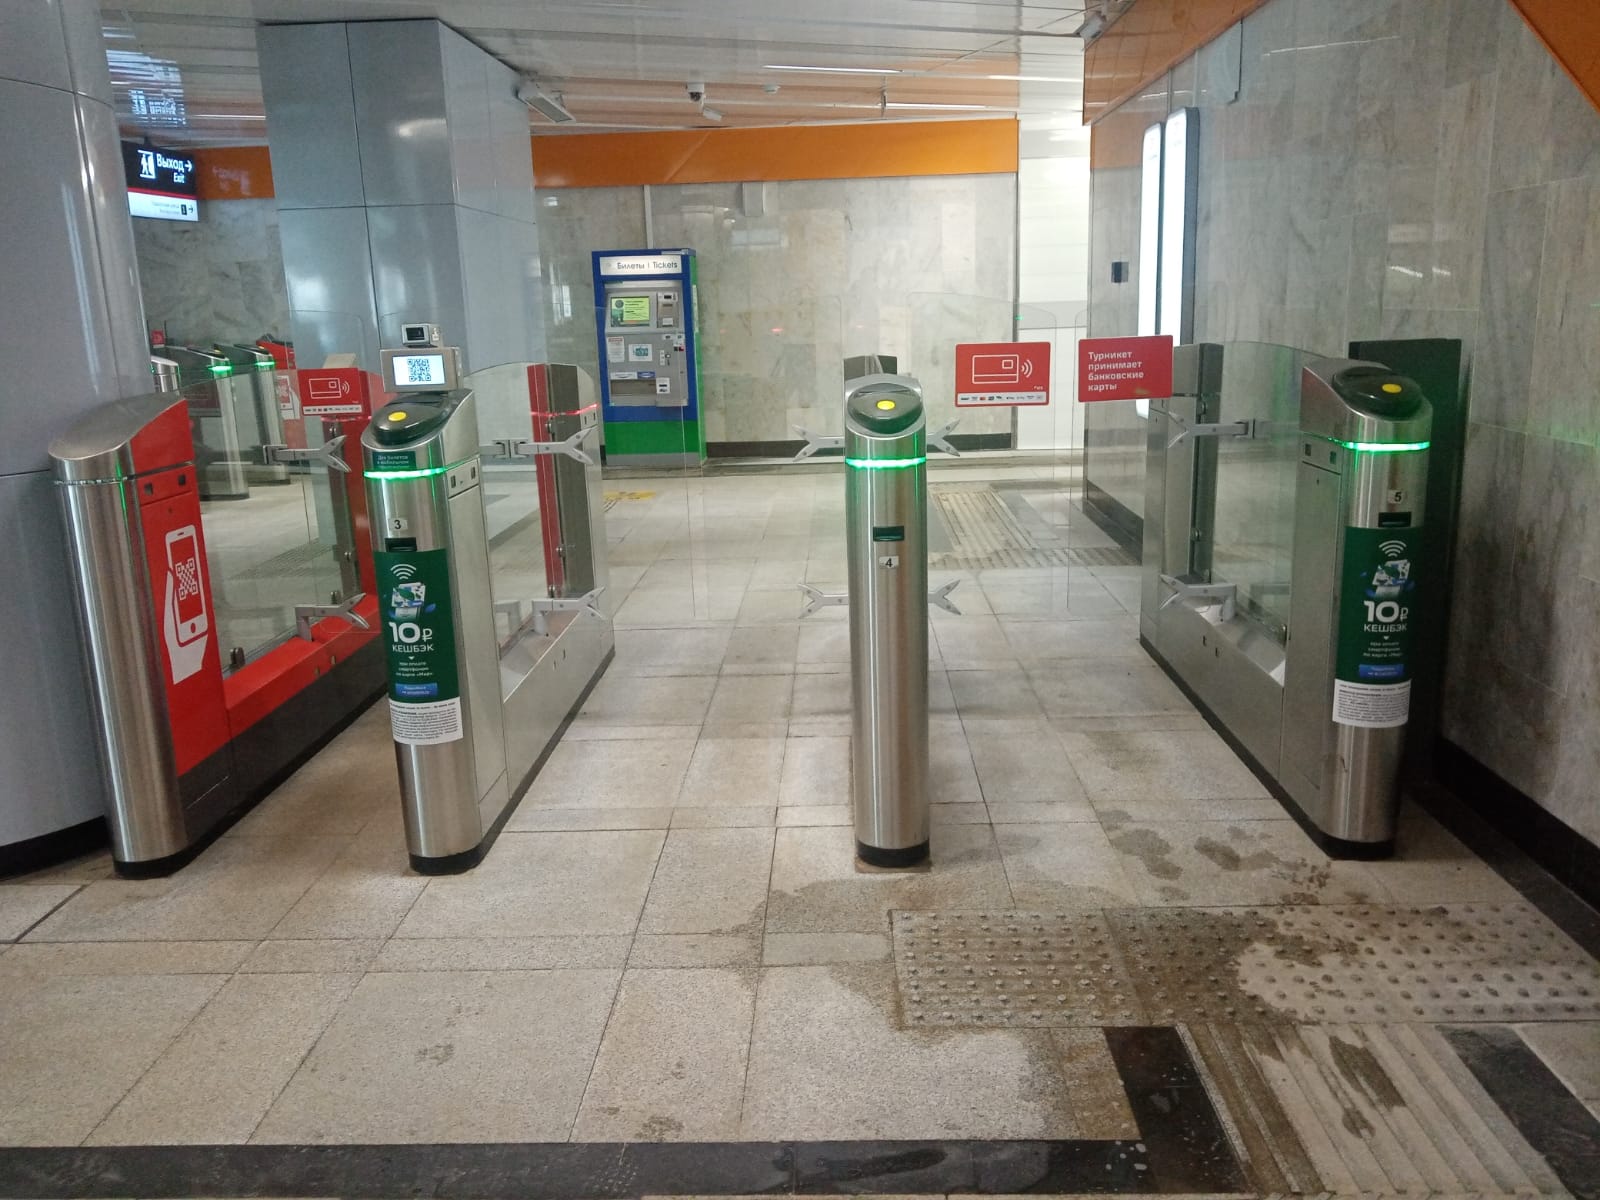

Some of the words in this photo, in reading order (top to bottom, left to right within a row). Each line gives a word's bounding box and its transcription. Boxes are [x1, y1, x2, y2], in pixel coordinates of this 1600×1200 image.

[156, 153, 185, 172] Выход
[173, 172, 185, 184] Exit
[617, 262, 645, 270] Билеты
[653, 261, 678, 269] Tickets
[1088, 351, 1133, 362] Турникет
[1088, 361, 1142, 372] принимает
[1088, 371, 1144, 381] банковские
[1088, 383, 1117, 392] карты
[1394, 491, 1402, 502] 5
[394, 519, 401, 530] 3
[885, 557, 893, 568] 4
[1364, 623, 1408, 633] КЕШБЭК
[392, 643, 435, 653] КЕШБЭК
